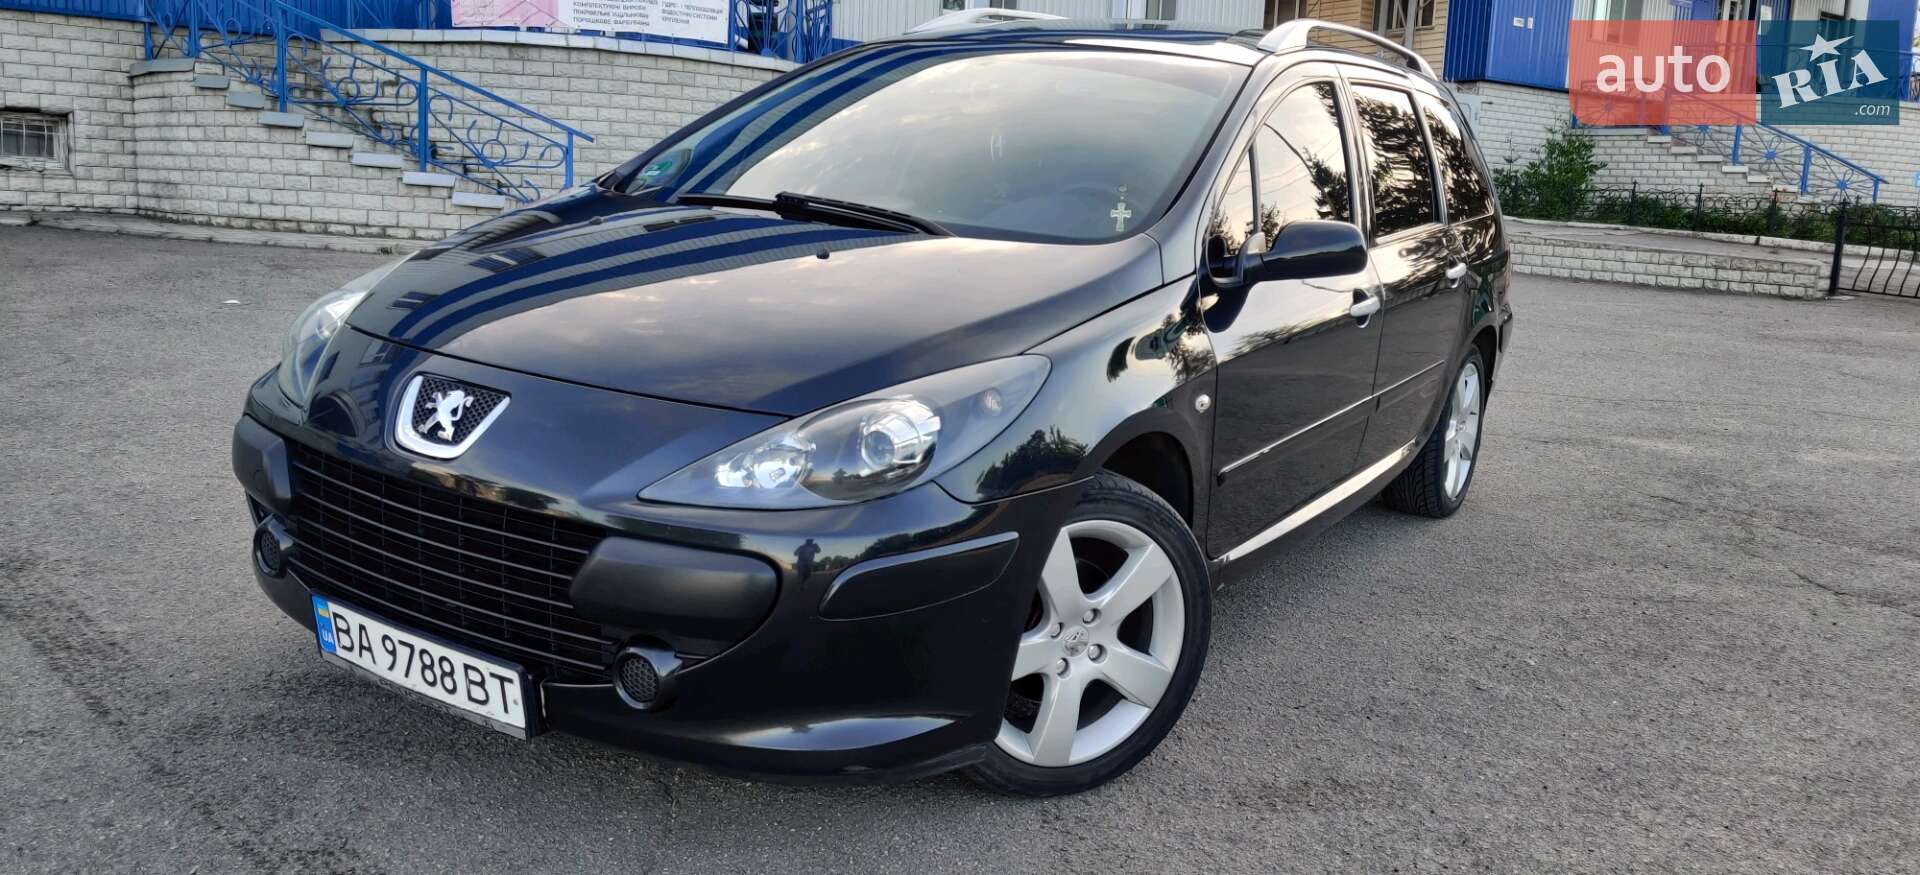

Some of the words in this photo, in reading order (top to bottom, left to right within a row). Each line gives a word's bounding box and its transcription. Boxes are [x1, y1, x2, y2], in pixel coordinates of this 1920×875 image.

[573, 2, 620, 11] КОМПЛЕКТУІ
[322, 630, 335, 644] UA
[332, 612, 377, 665] BA
[381, 634, 458, 695] 9788
[463, 662, 514, 714] BT
